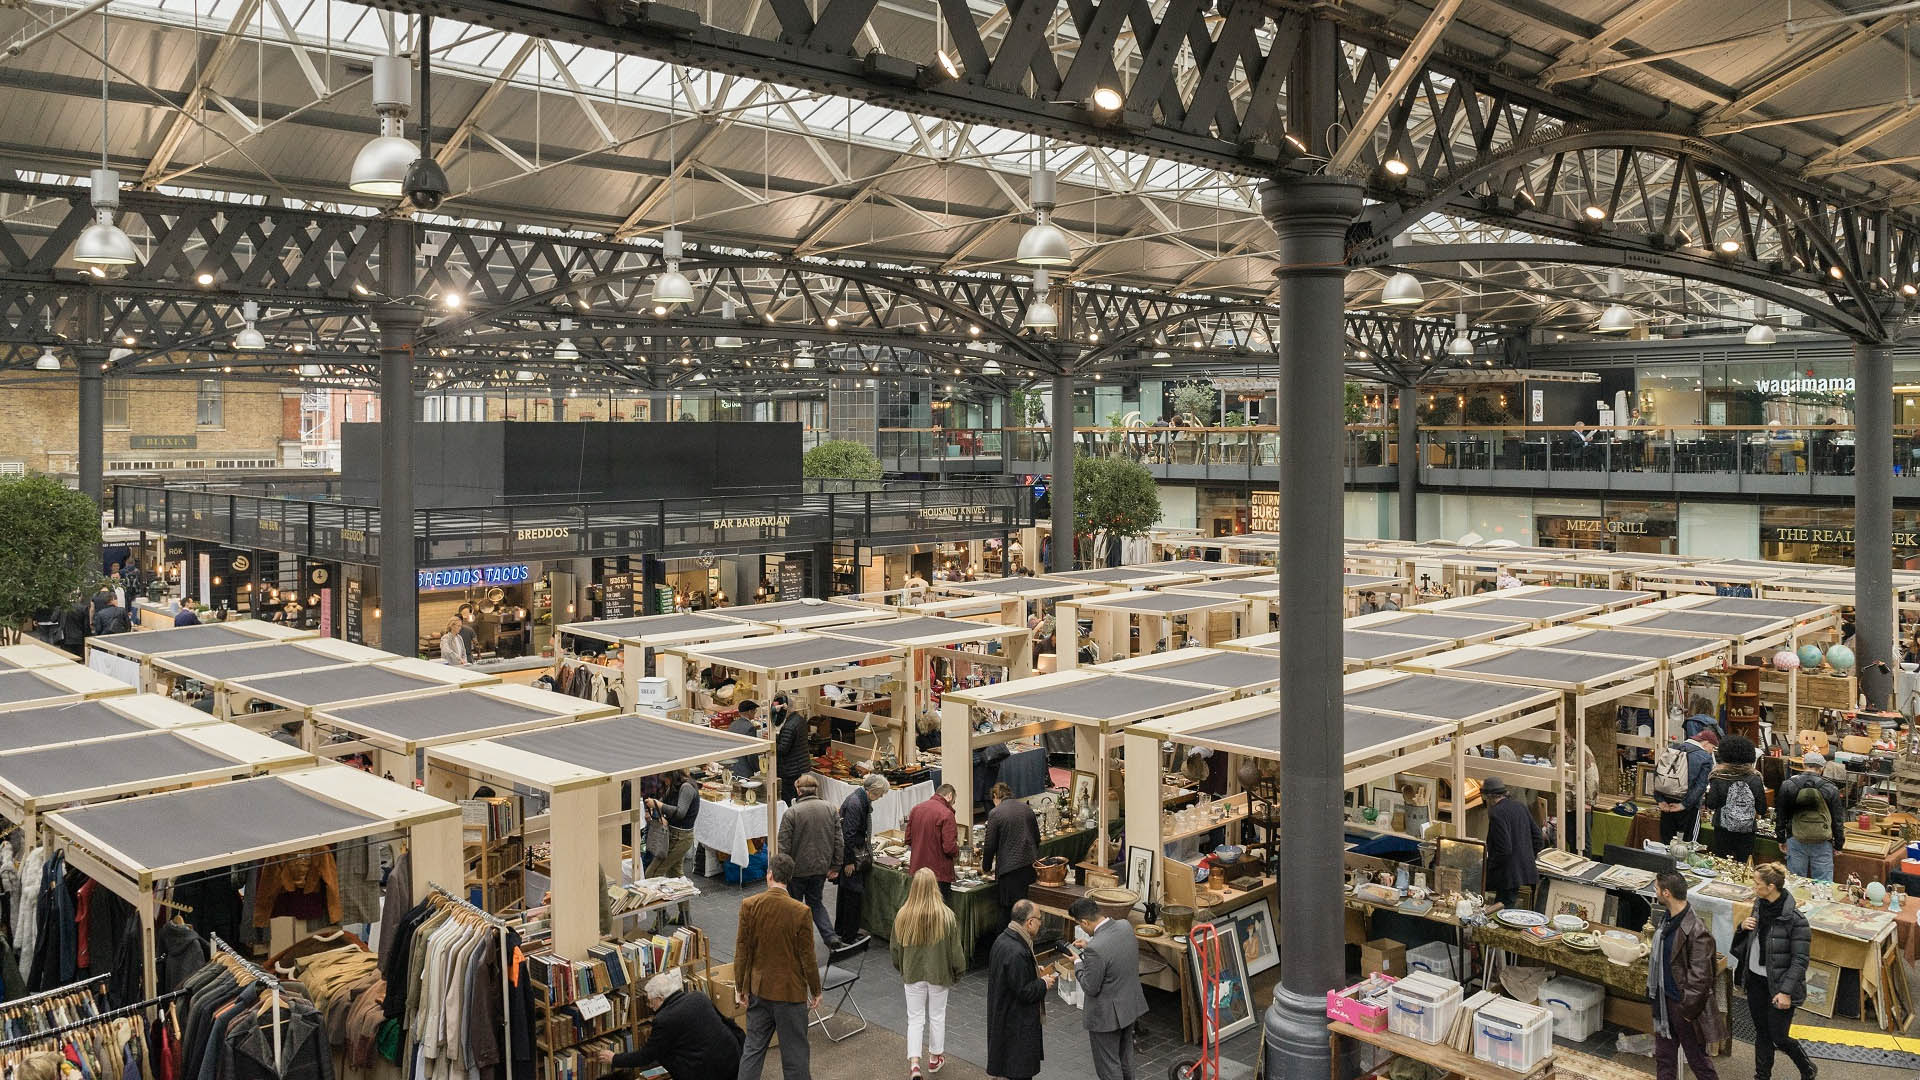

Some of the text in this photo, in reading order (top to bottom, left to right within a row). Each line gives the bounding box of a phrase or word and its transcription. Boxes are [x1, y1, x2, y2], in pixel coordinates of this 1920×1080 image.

[1754, 378, 1856, 395] wagamama
[920, 505, 986, 517] THOUSAND KNIVES
[1251, 505, 1280, 519] BURG
[713, 515, 790, 529] BAR BARBARIAN
[1251, 518, 1280, 531] KITCH
[1566, 519, 1648, 534] MEZE GRILL
[518, 527, 569, 541] BREDDOS
[1776, 528, 1809, 541] THE
[1811, 529, 1856, 543] REAL
[418, 565, 529, 587] BREDDOS TACOS
